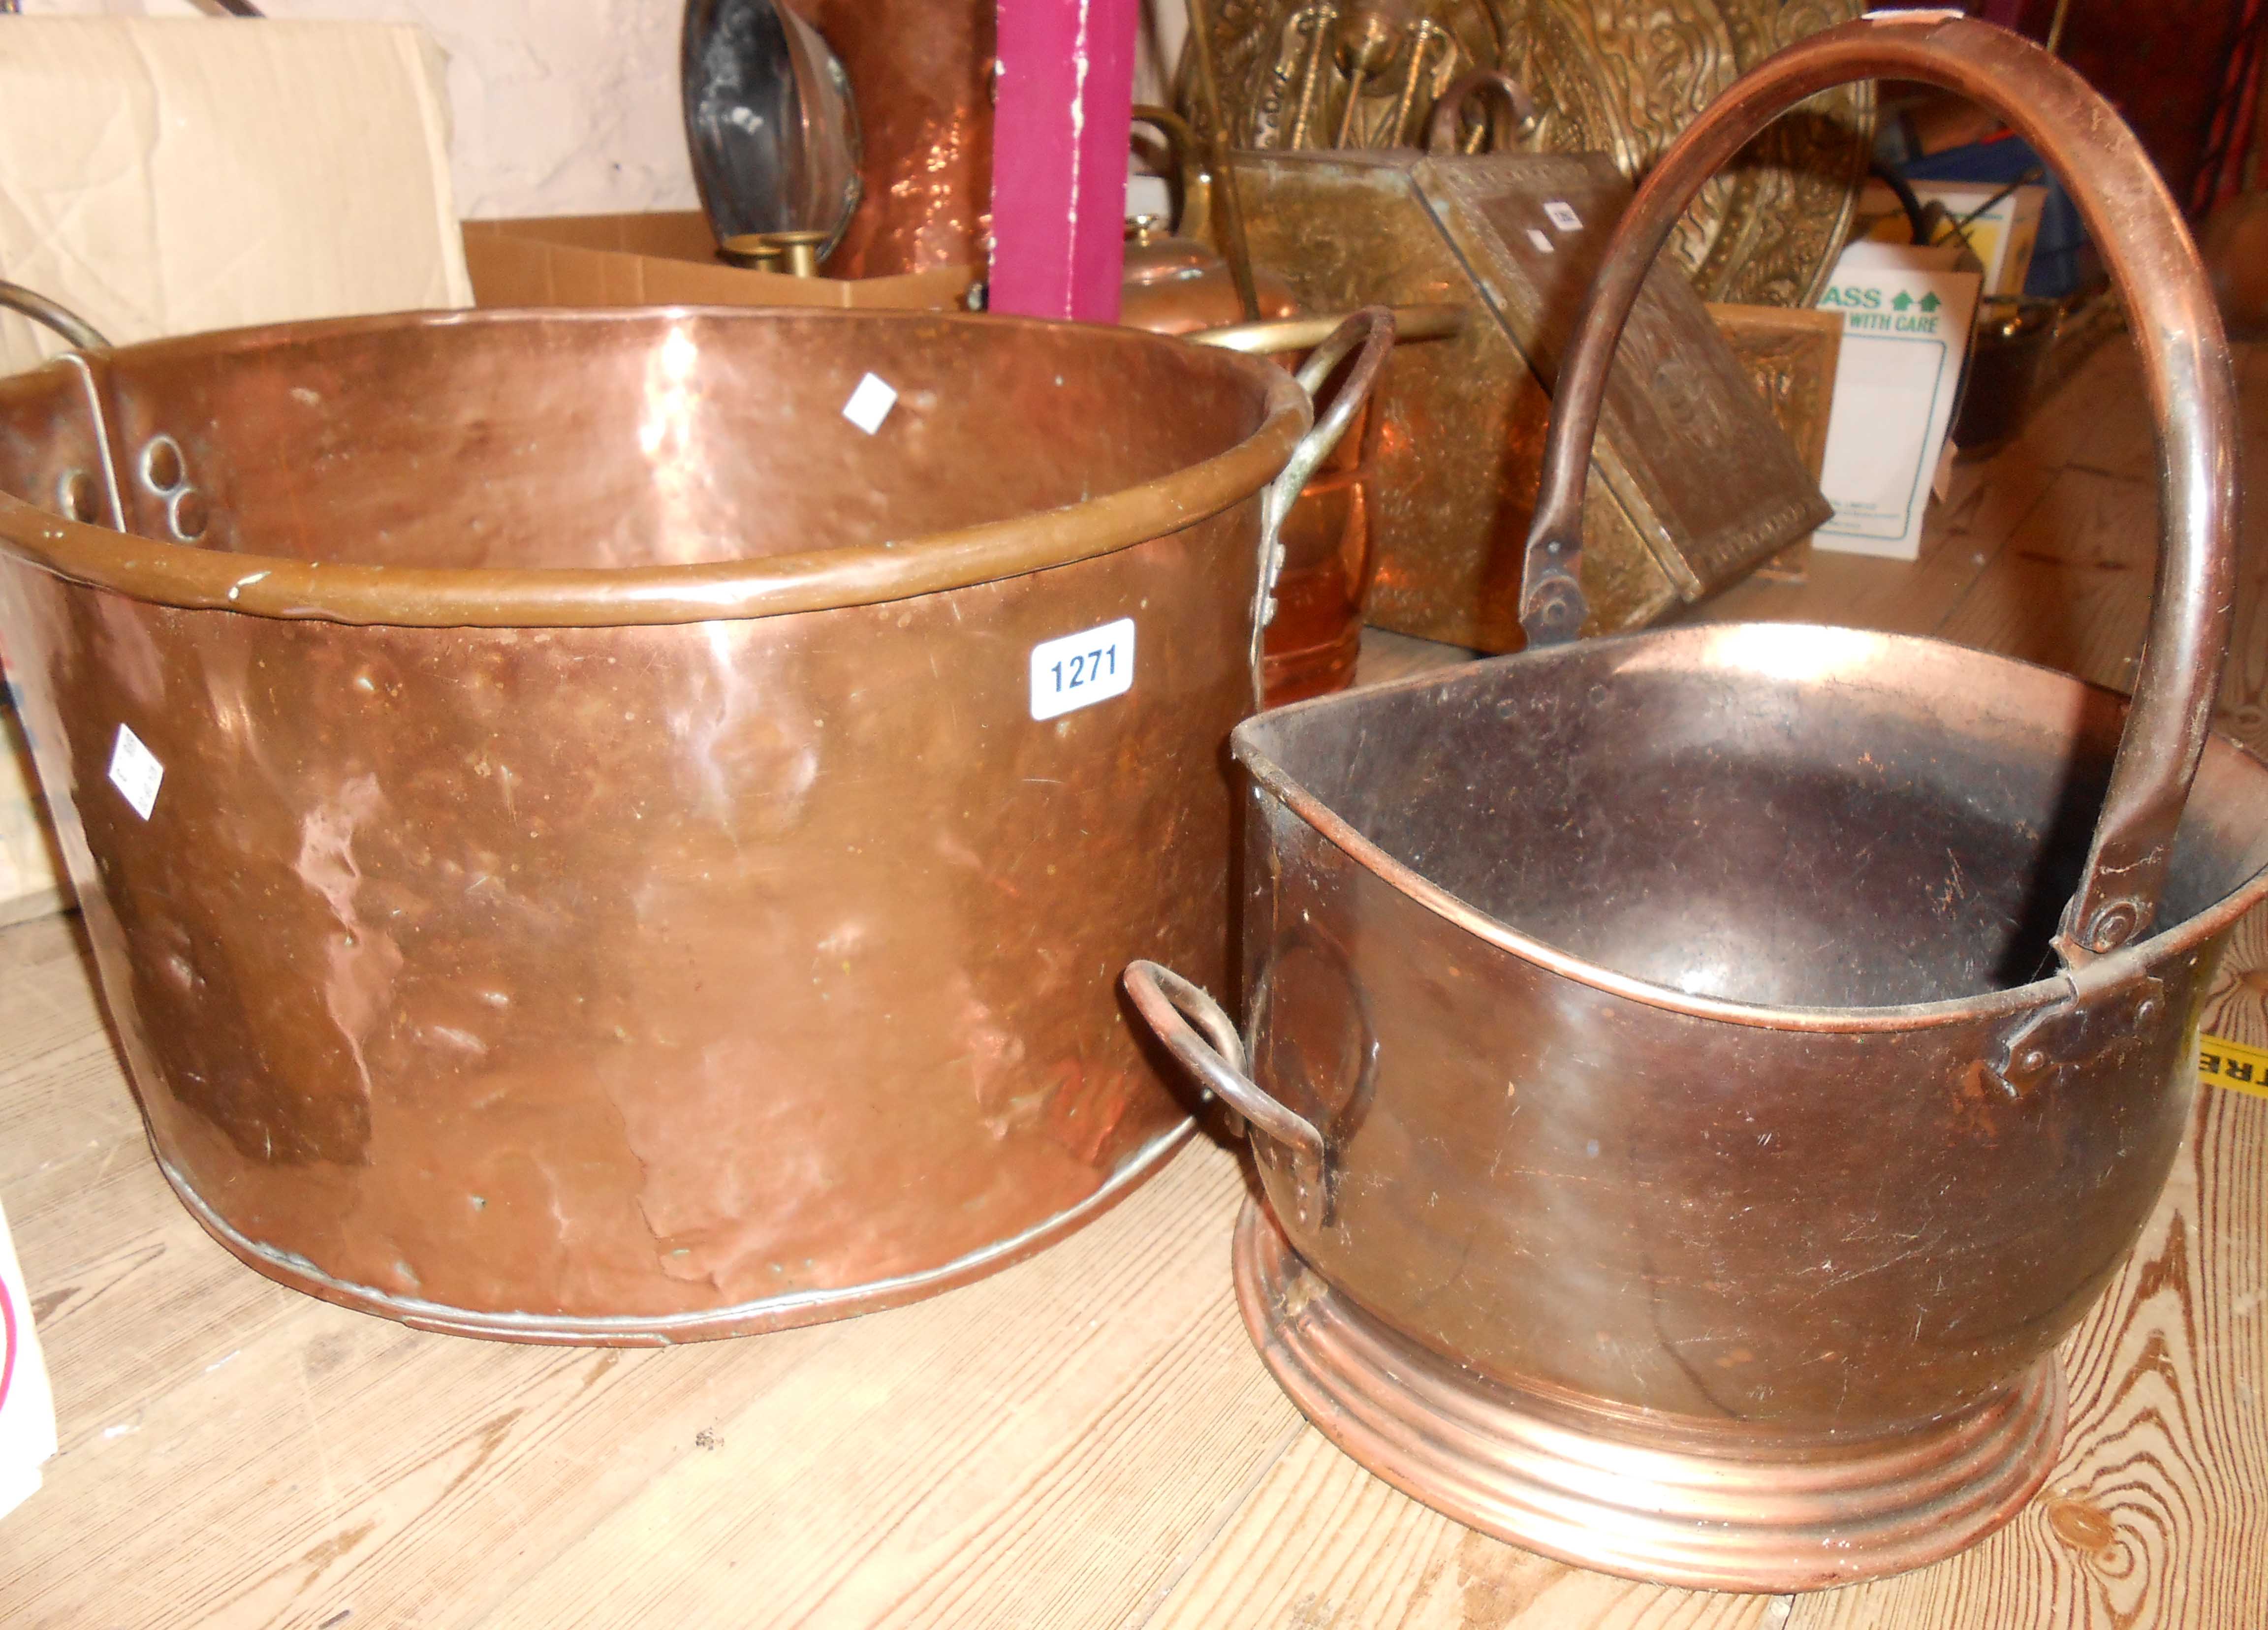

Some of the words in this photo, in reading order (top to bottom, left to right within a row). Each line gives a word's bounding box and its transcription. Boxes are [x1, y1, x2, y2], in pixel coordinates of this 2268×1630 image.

[1821, 286, 1882, 308] ASS
[1850, 313, 1892, 331] WITH
[1895, 315, 1939, 333] CARE
[1051, 643, 1116, 692] 1271
